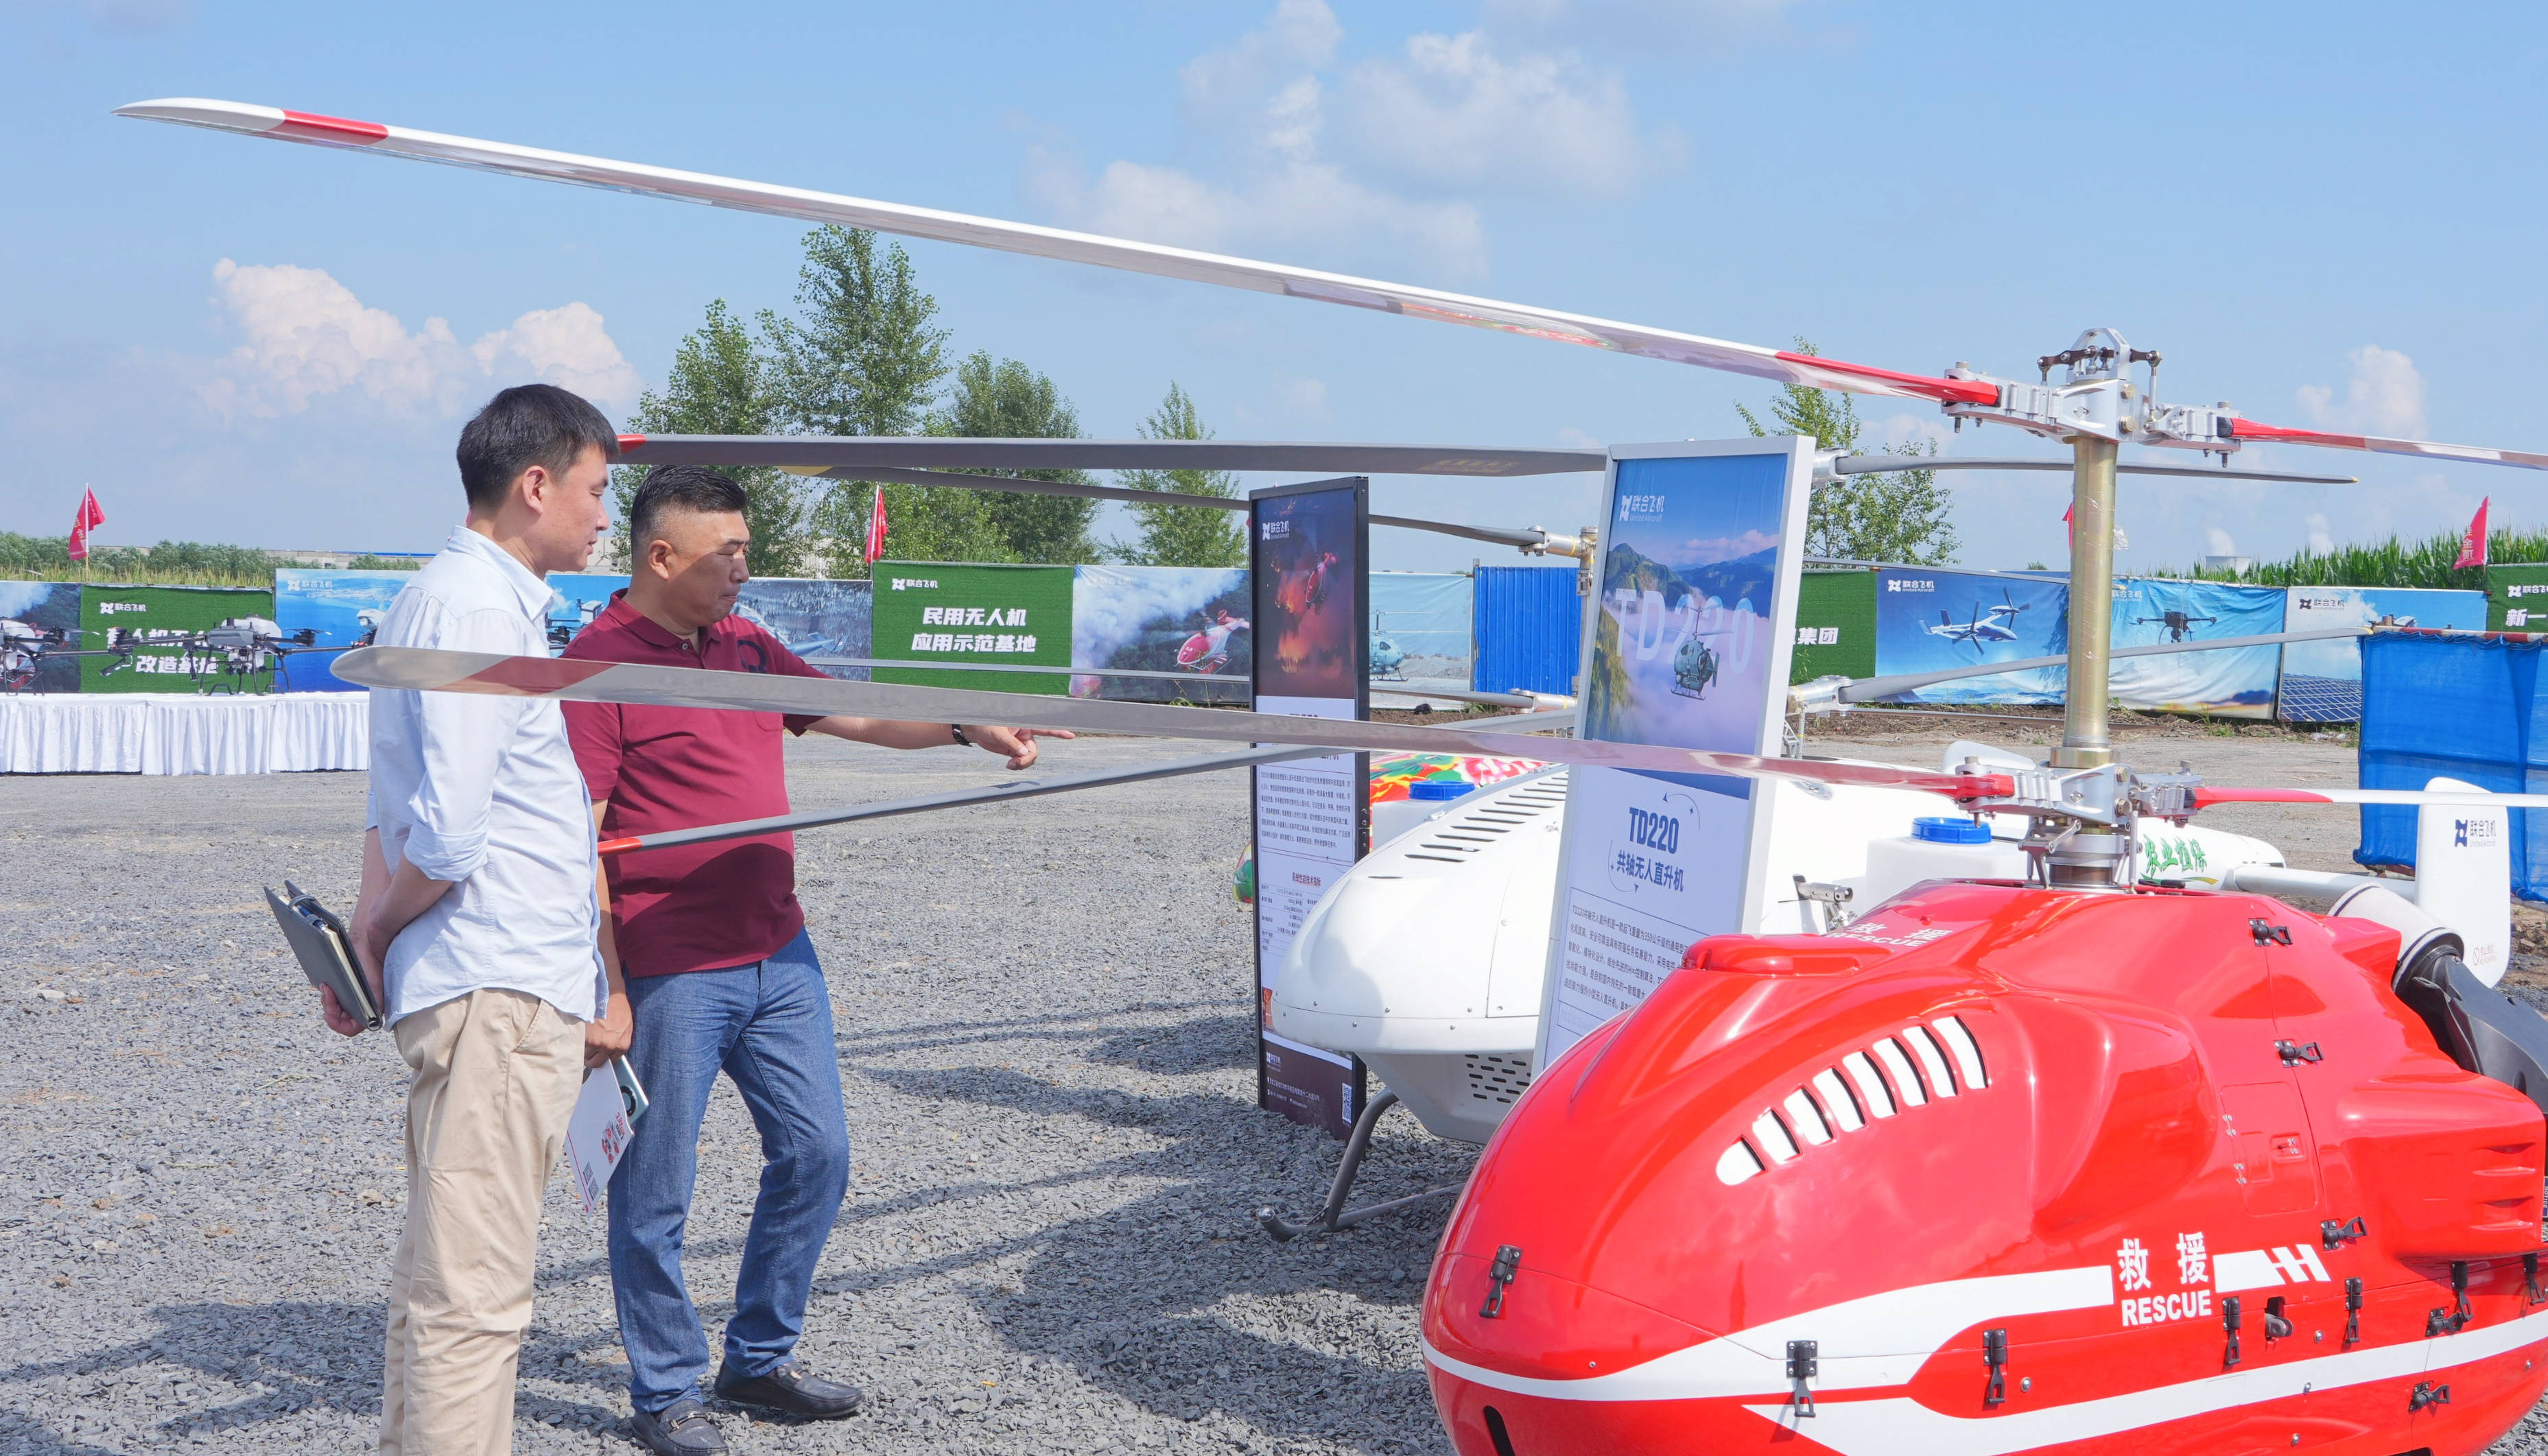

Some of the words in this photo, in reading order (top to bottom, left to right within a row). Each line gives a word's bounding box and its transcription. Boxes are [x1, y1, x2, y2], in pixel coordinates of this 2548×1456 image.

[1631, 494, 1665, 512] 联合飞机
[1271, 521, 1289, 533] 联合飞机
[906, 579, 938, 588] 联合飞机
[1902, 580, 1935, 588] 联合飞机
[2523, 585, 2548, 594] 联合飞
[115, 603, 147, 612] 联合飞机
[2313, 599, 2345, 607] 联合飞机
[923, 607, 1027, 626] 民用无人机
[911, 633, 1037, 652] 应用示范基地
[1795, 627, 1839, 645] 集团
[1629, 807, 1679, 855] TD220
[2470, 820, 2497, 837] 联合飞机
[2143, 833, 2208, 879] 农业植保
[1616, 849, 1684, 893] 共轴无人直升机
[1825, 932, 1928, 946] RESCUE
[2117, 1232, 2209, 1291] 救援
[2121, 1289, 2212, 1327] RESCUE
